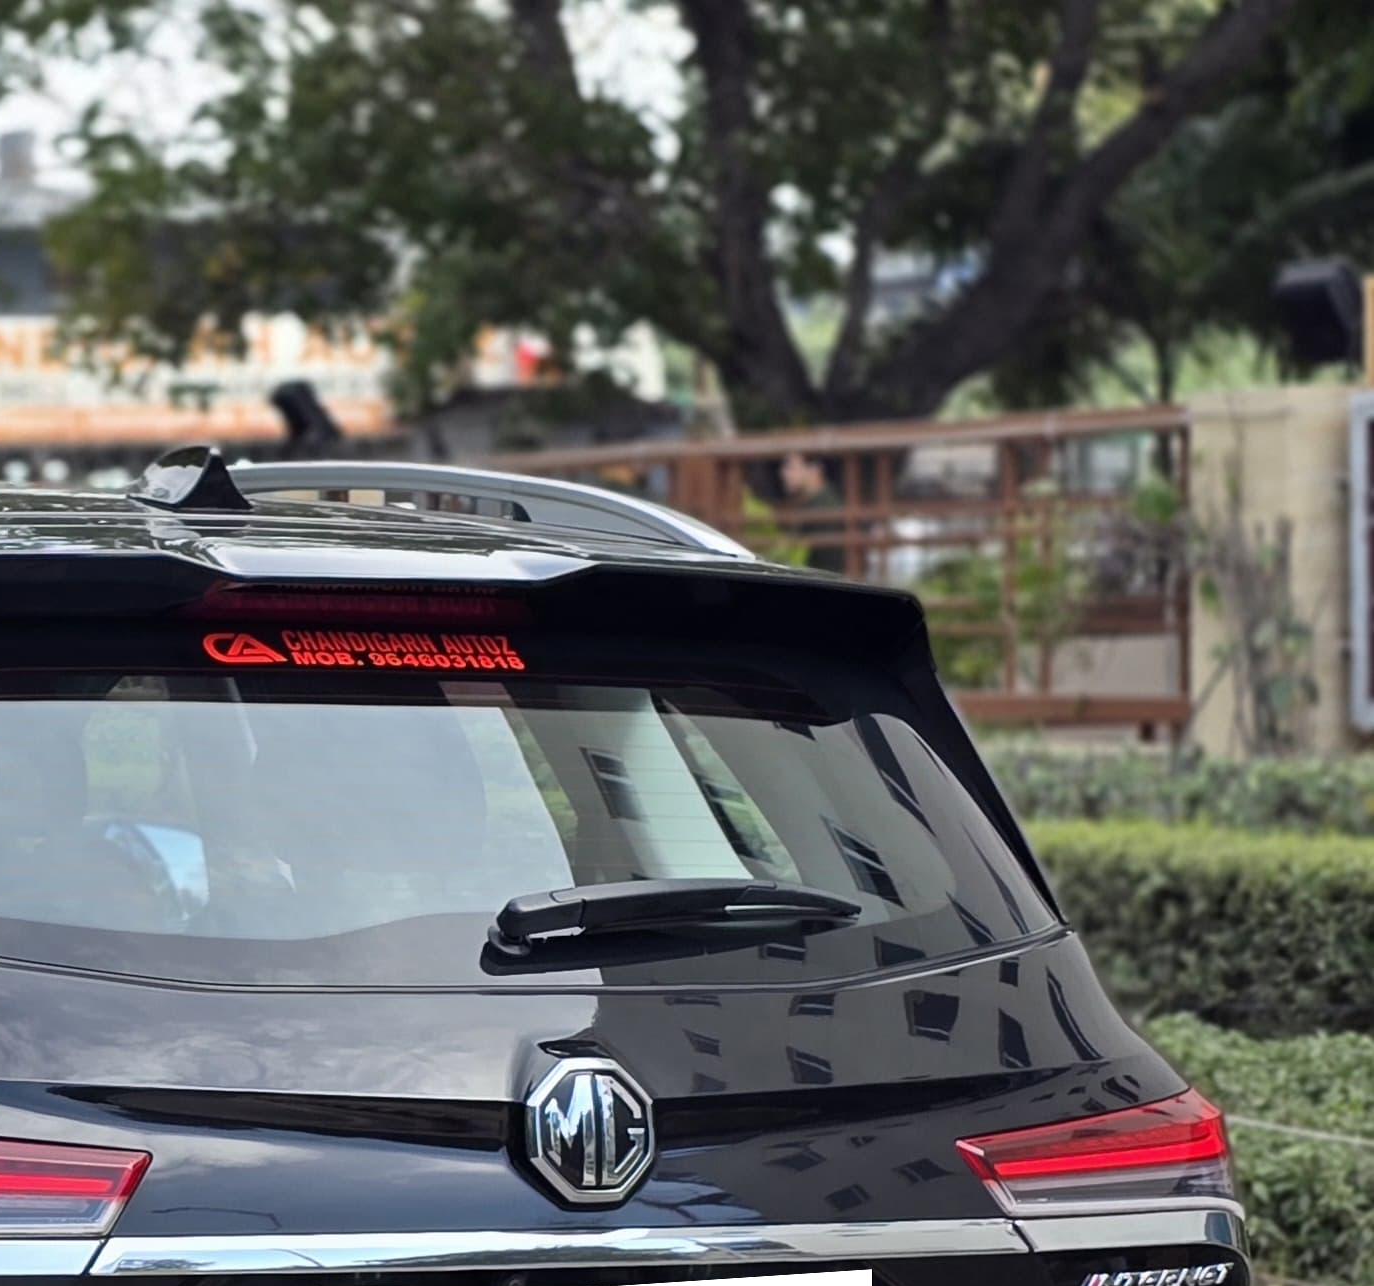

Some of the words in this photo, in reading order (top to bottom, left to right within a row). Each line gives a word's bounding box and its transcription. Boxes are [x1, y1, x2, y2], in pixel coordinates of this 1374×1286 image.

[282, 630, 438, 653] CHANDIGARH
[440, 634, 517, 656] AUTOZ
[291, 651, 364, 665] MOB.
[543, 1070, 646, 1187] MG
